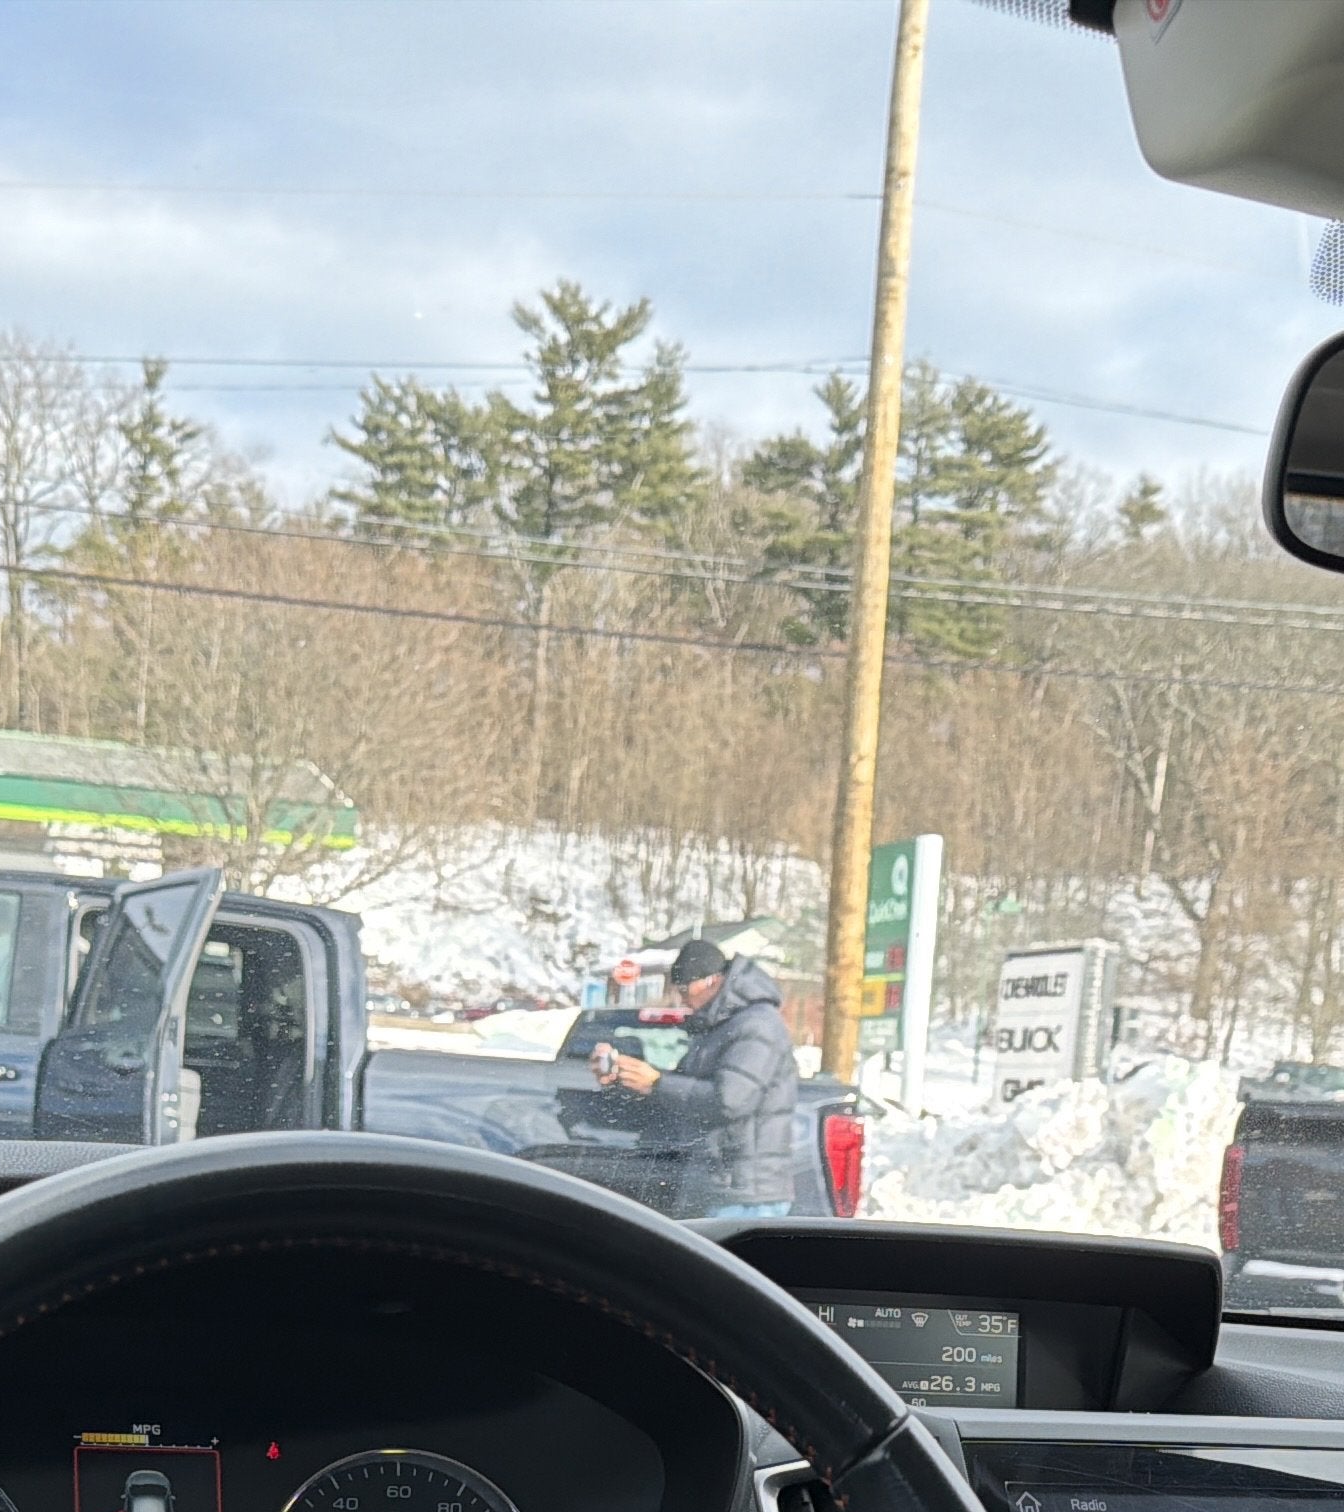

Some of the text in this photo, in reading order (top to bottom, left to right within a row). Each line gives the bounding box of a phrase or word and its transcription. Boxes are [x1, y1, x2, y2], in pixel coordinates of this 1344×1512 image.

[997, 1025, 1063, 1053] BUICK
[818, 1305, 902, 1323] HI AUTO
[941, 1346, 1003, 1364] 200 miles
[930, 1375, 976, 1392] 26.3
[980, 1382, 1001, 1393] MPG
[132, 1423, 162, 1436] MPG
[386, 1485, 412, 1499] 60
[332, 1497, 359, 1511] 40
[1070, 1498, 1107, 1512] Radio
